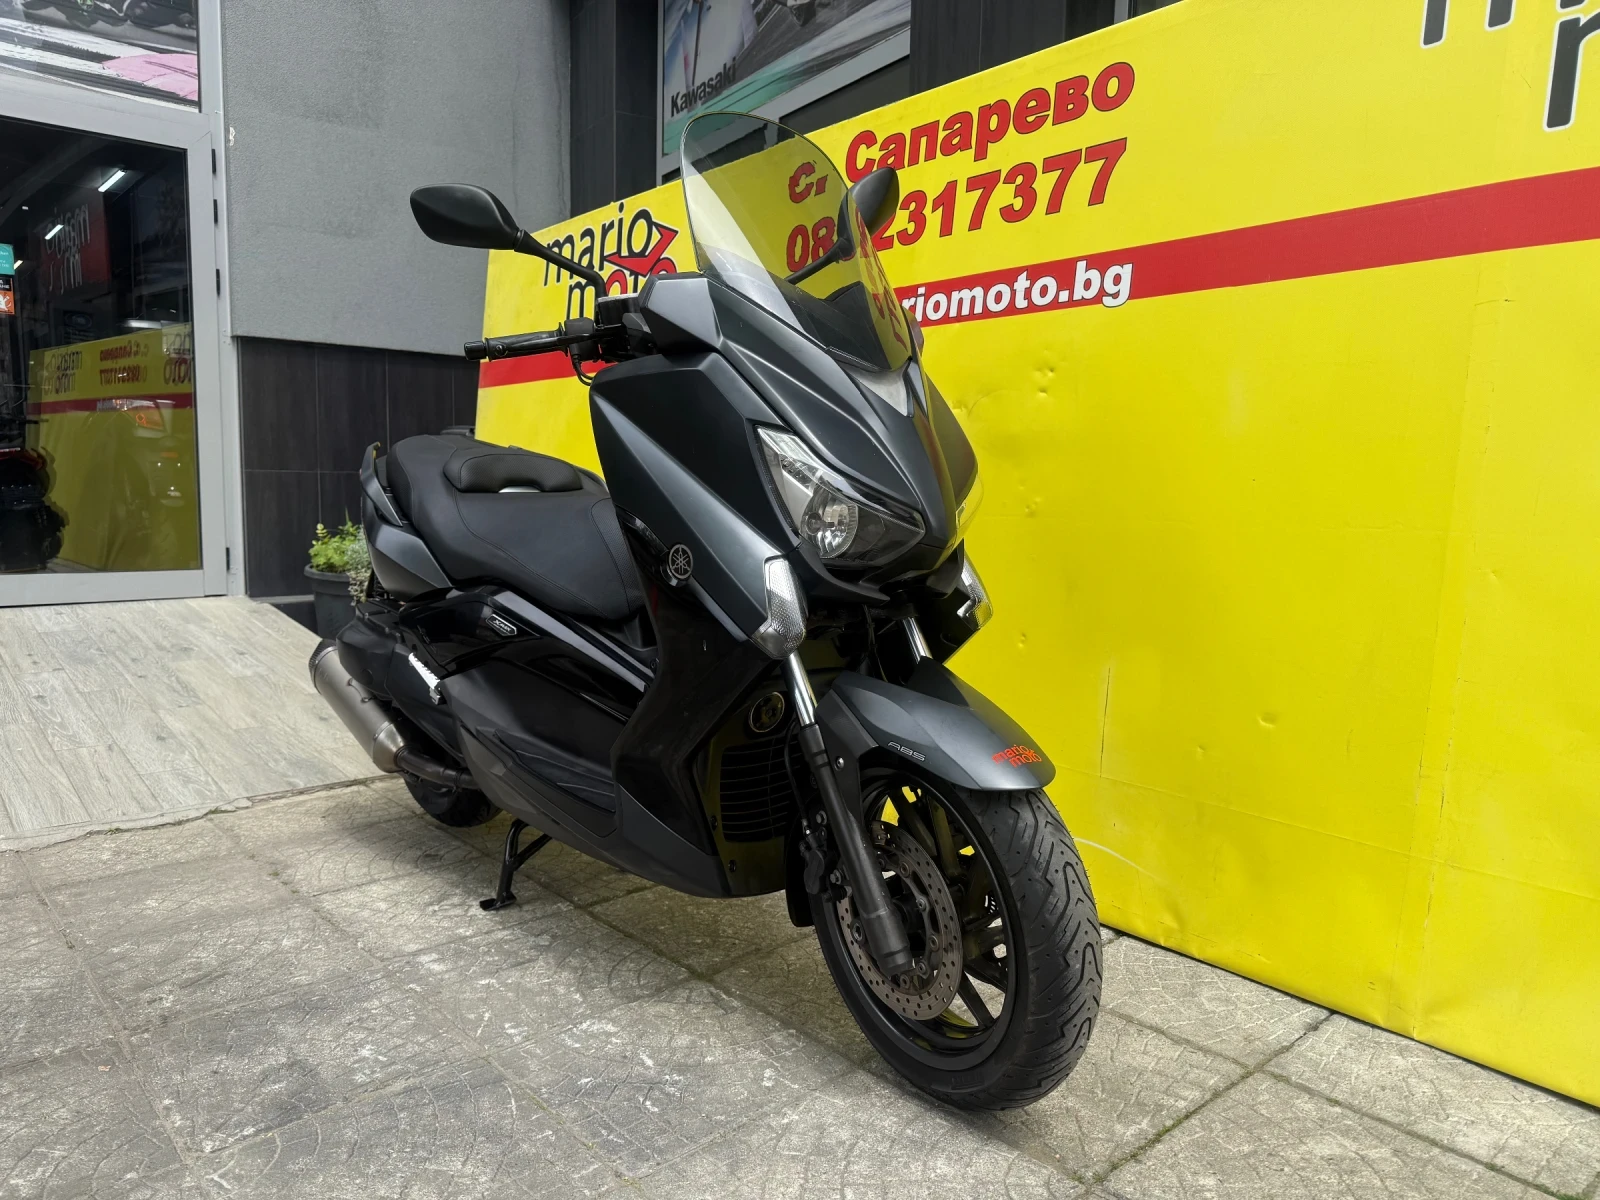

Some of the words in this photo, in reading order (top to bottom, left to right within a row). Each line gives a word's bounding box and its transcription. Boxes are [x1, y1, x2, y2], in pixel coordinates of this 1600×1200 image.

[671, 56, 736, 118] Kawasaki
[845, 61, 1135, 184] Сапарево
[786, 137, 1127, 273] 082317377
[544, 201, 653, 287] mario
[888, 741, 925, 762] ABS
[992, 744, 1029, 764] mario
[1009, 752, 1042, 768] moto
